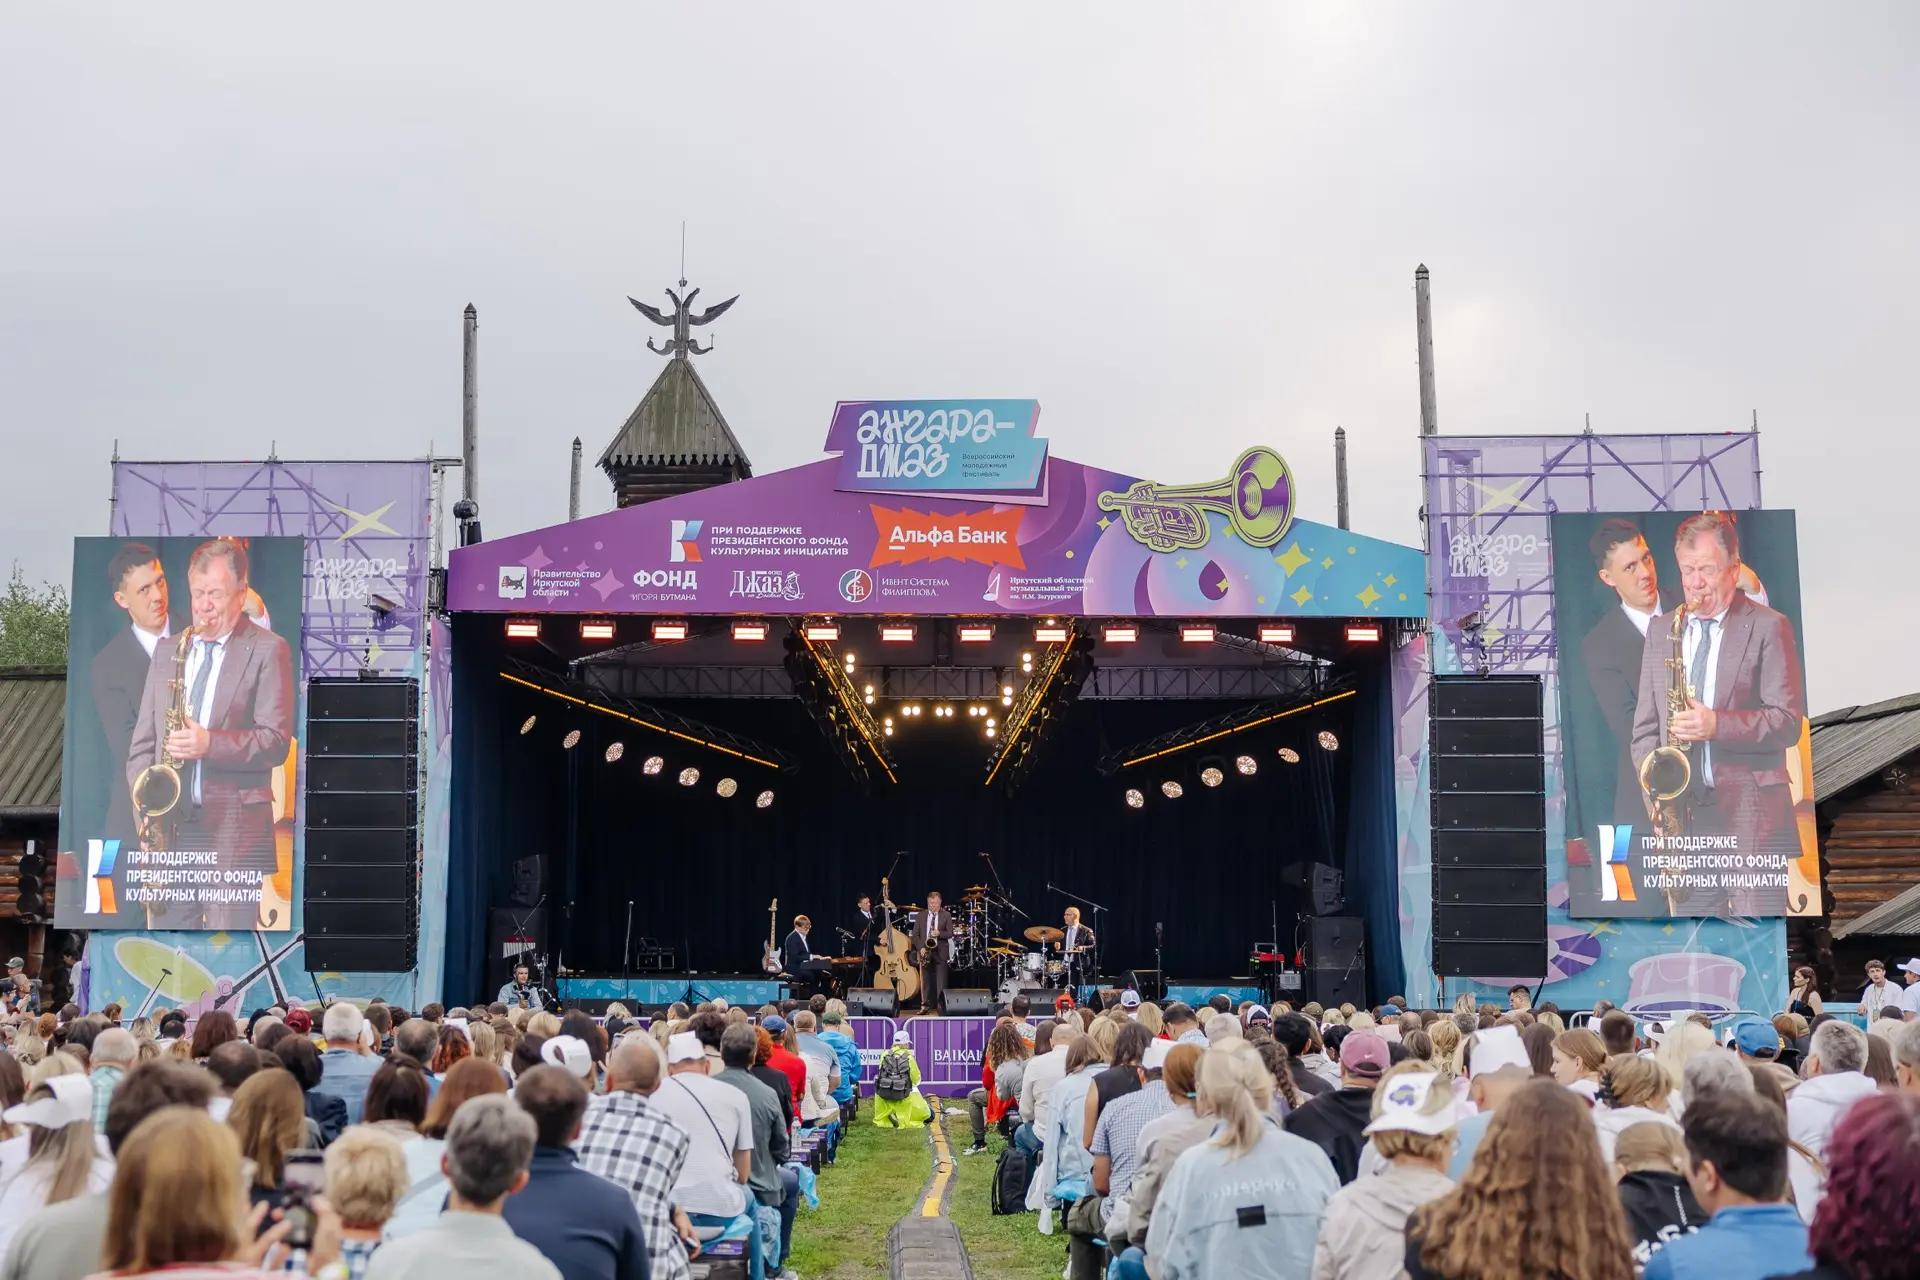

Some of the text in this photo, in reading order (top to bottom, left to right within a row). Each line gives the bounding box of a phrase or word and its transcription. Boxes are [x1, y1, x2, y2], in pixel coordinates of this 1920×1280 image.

[711, 526, 803, 535] ПРИ ПОДДЕРЖКЕ
[889, 525, 1008, 548] Альфа Банк
[711, 537, 849, 546] ПРЕЗИДЕНТСКОГО ФОНДА
[711, 547, 849, 556] КУЛЬТУРНЫХ ИНИЦИАТИВ
[533, 569, 601, 579] Правительство
[633, 570, 698, 590] ФОНД
[533, 578, 580, 588] Иркутской
[729, 570, 782, 597] Джаз
[1009, 576, 1094, 585] Иркутский областной
[532, 587, 569, 597] области
[1009, 585, 1065, 593] музыкальный
[632, 593, 697, 601] ИГОРЯ БУТМАНА
[1641, 835, 1738, 851] ПРИ ПОДДЕРЖКЕ
[127, 851, 218, 866] ПРИ ПОДДЕРЖКЕ
[1643, 854, 1788, 870] ПРЕЗИДЕНТСКОГО ФОНДА
[126, 869, 263, 885] ПРЕЗИДЕНТСКОГО ФОНДА
[1643, 873, 1789, 889] КУЛЬТУРНЫХ ИНИЦИАТИВ
[125, 888, 263, 904] КУЛЬТУРНЫХ ИНИЦИАТИВ
